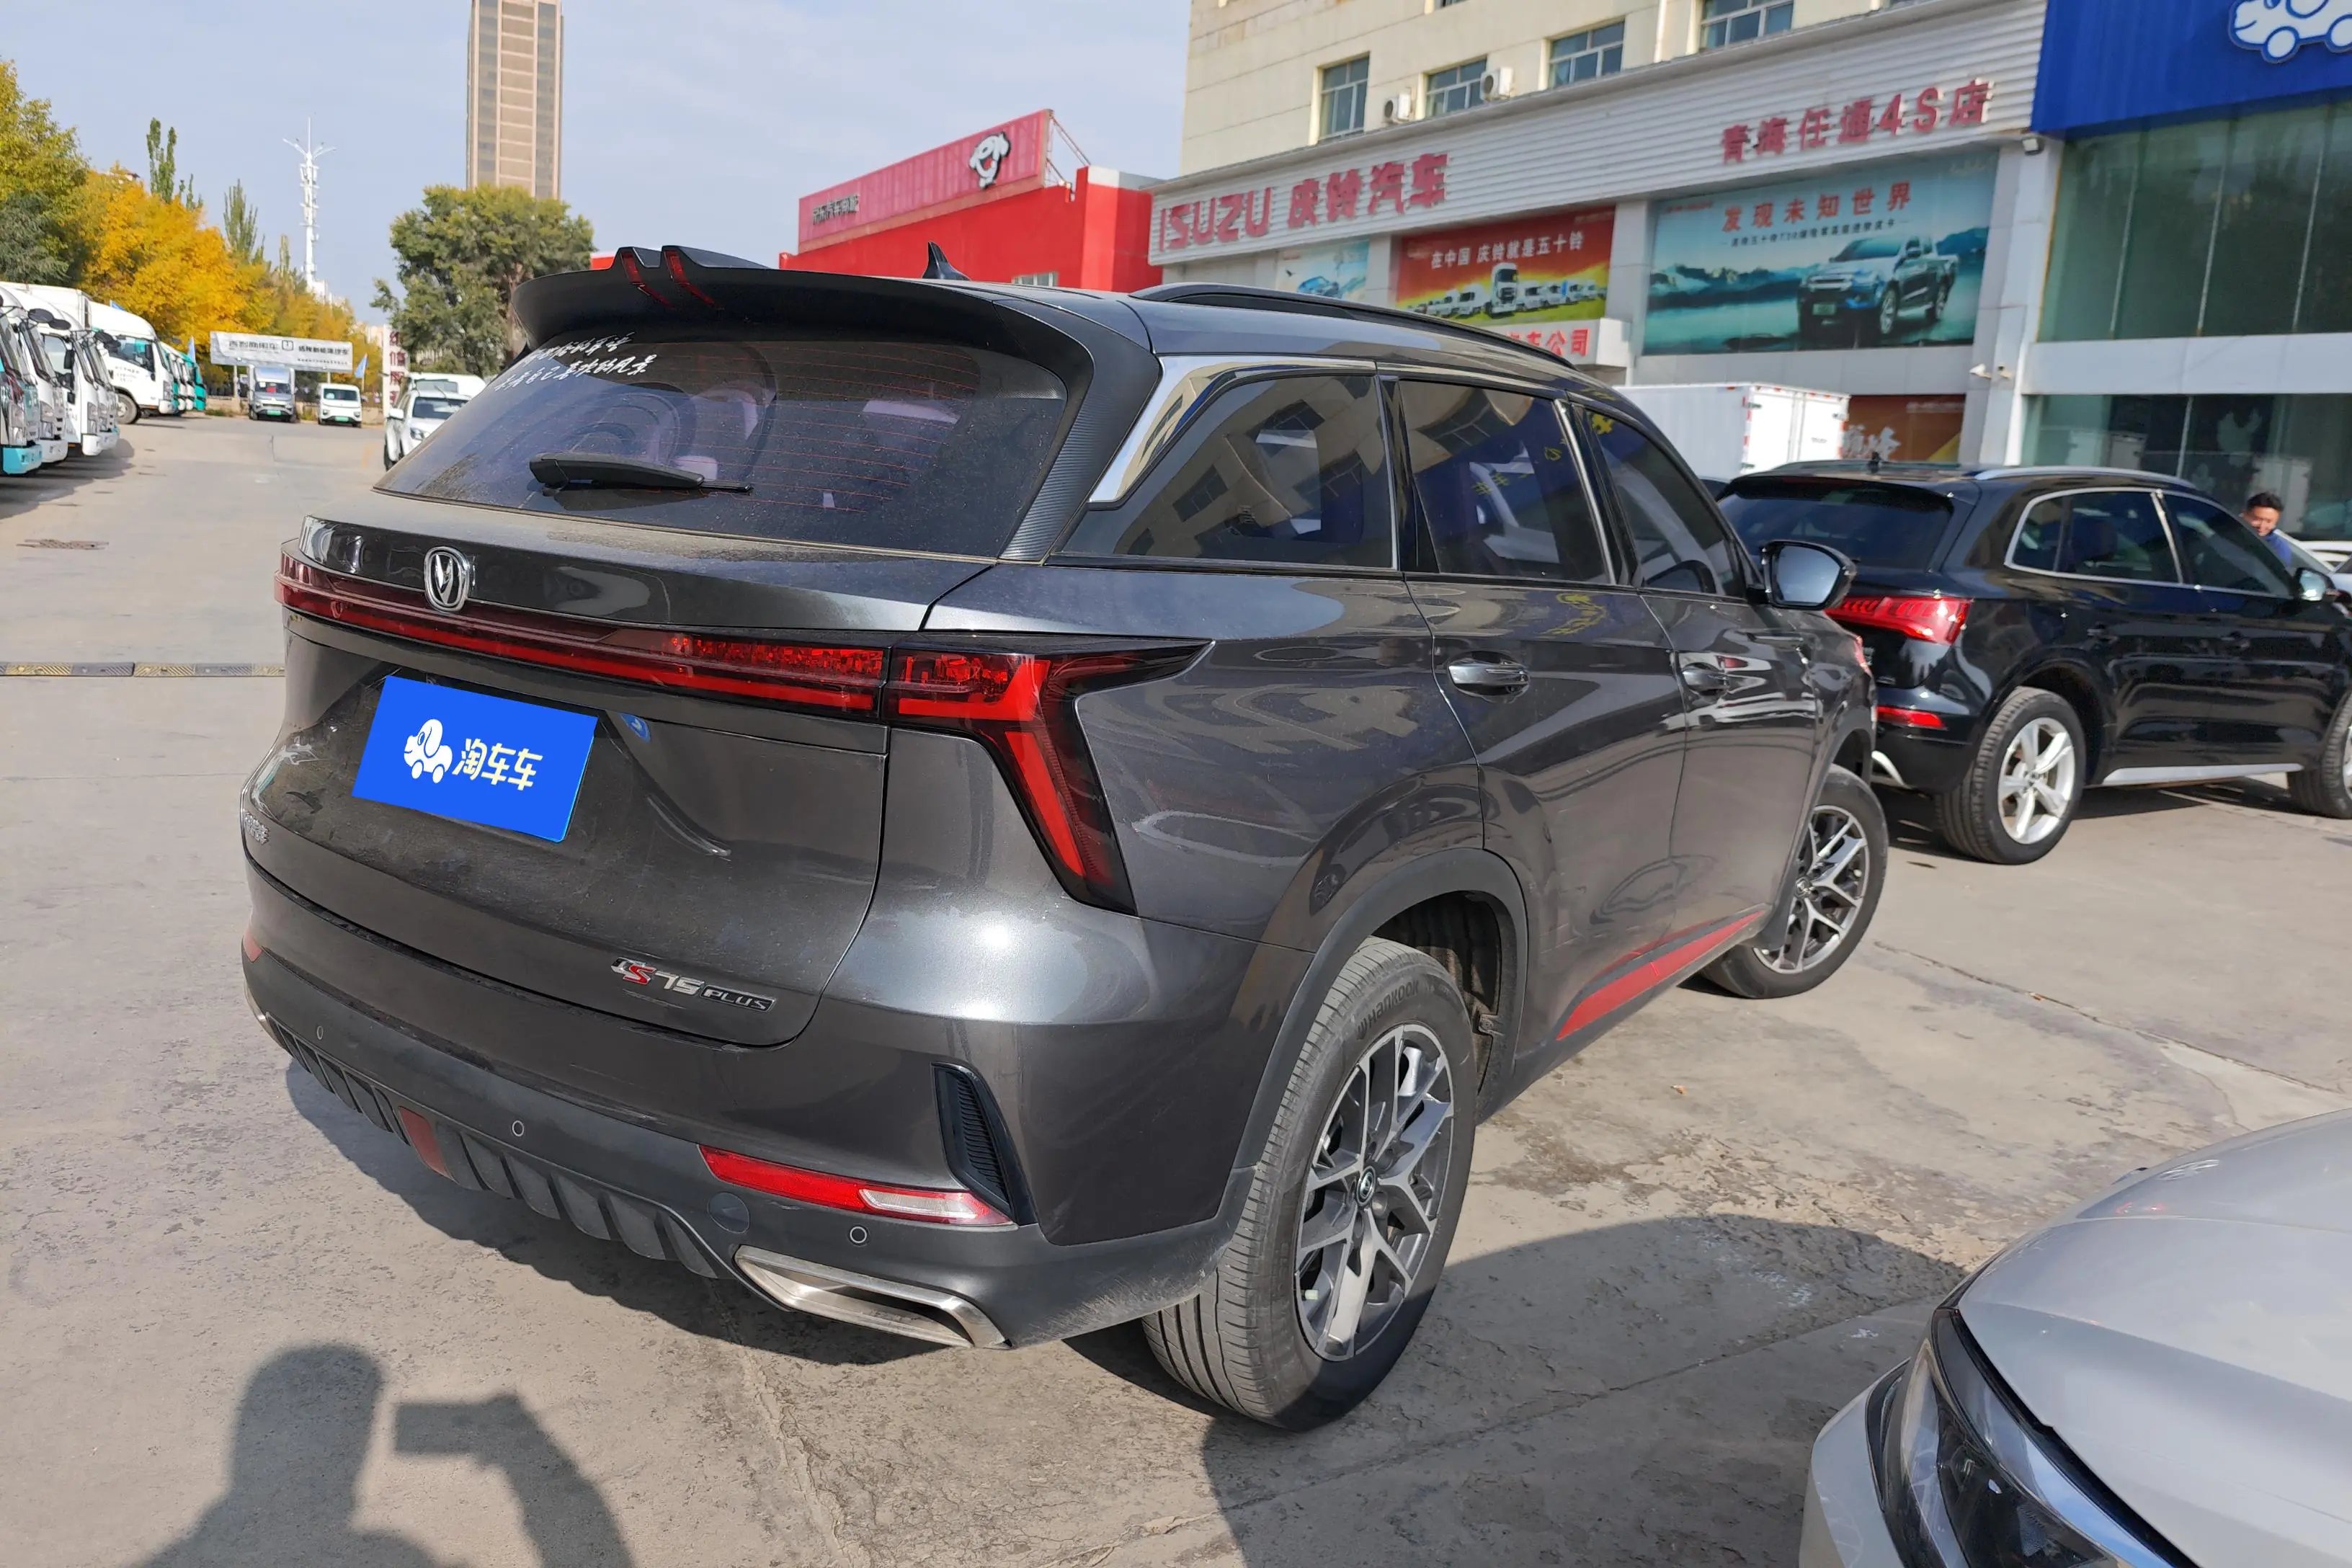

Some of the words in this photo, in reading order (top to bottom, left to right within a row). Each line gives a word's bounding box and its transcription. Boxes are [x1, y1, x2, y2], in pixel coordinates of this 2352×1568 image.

[1721, 78, 1992, 164] 青海任通4S店
[1159, 186, 1271, 251] ISUZU
[1287, 152, 1448, 229] 庆铃汽车
[1721, 181, 1912, 233] 发现未知世界
[1430, 247, 1471, 270] 在中国
[1476, 230, 1585, 264] 庆铃就是五十铃
[703, 987, 771, 1010] PLUS
